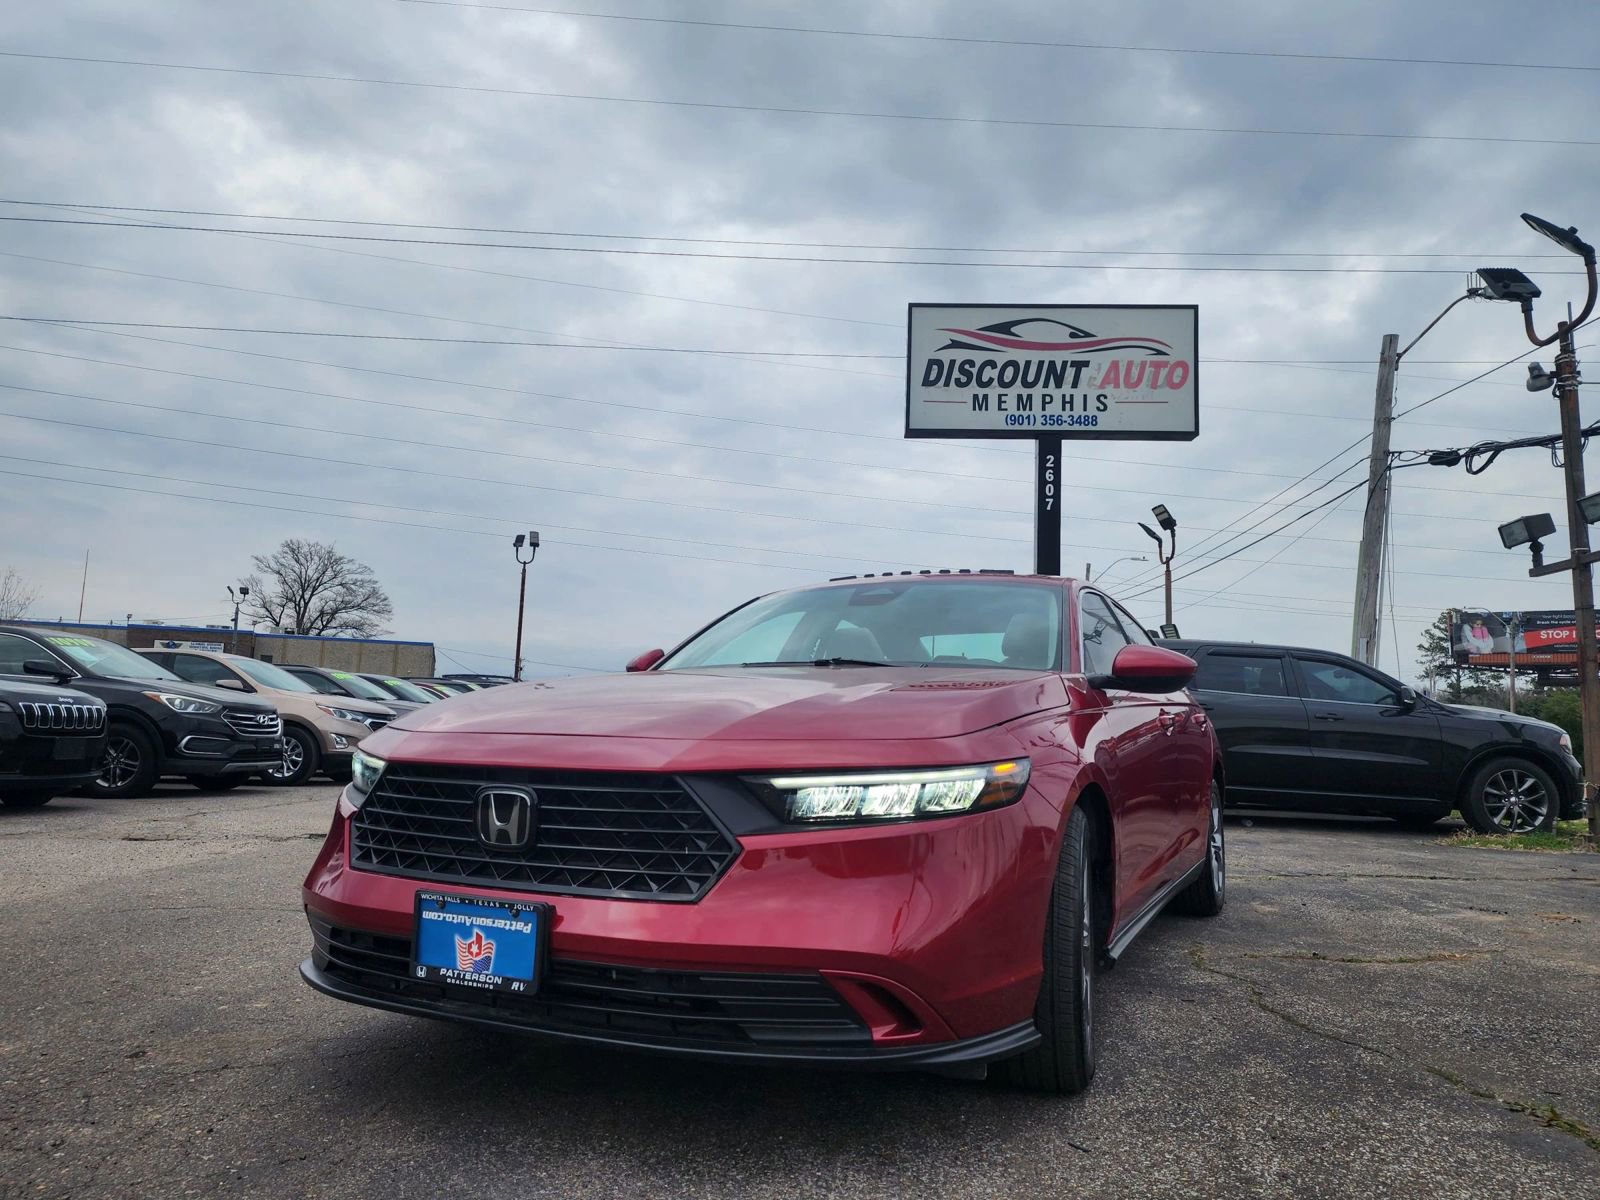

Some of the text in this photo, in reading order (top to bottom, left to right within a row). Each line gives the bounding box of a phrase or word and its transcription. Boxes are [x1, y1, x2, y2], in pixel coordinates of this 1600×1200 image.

[921, 358, 1190, 391] DISCOUNT AUTO
[972, 393, 1109, 412] MEMPHIS
[1005, 414, 1099, 427] (901) 356-3488
[1045, 455, 1055, 511] 2607
[1540, 630, 1569, 639] STOP
[420, 893, 461, 904] WICHITA FALLS
[474, 900, 500, 908] TEXAS
[513, 903, 534, 911] JOLLY
[422, 910, 533, 934] PattersonAuto.com
[439, 968, 503, 985] PATTERSON
[446, 978, 494, 990] DEALERSHIPS
[511, 981, 527, 991] RV
